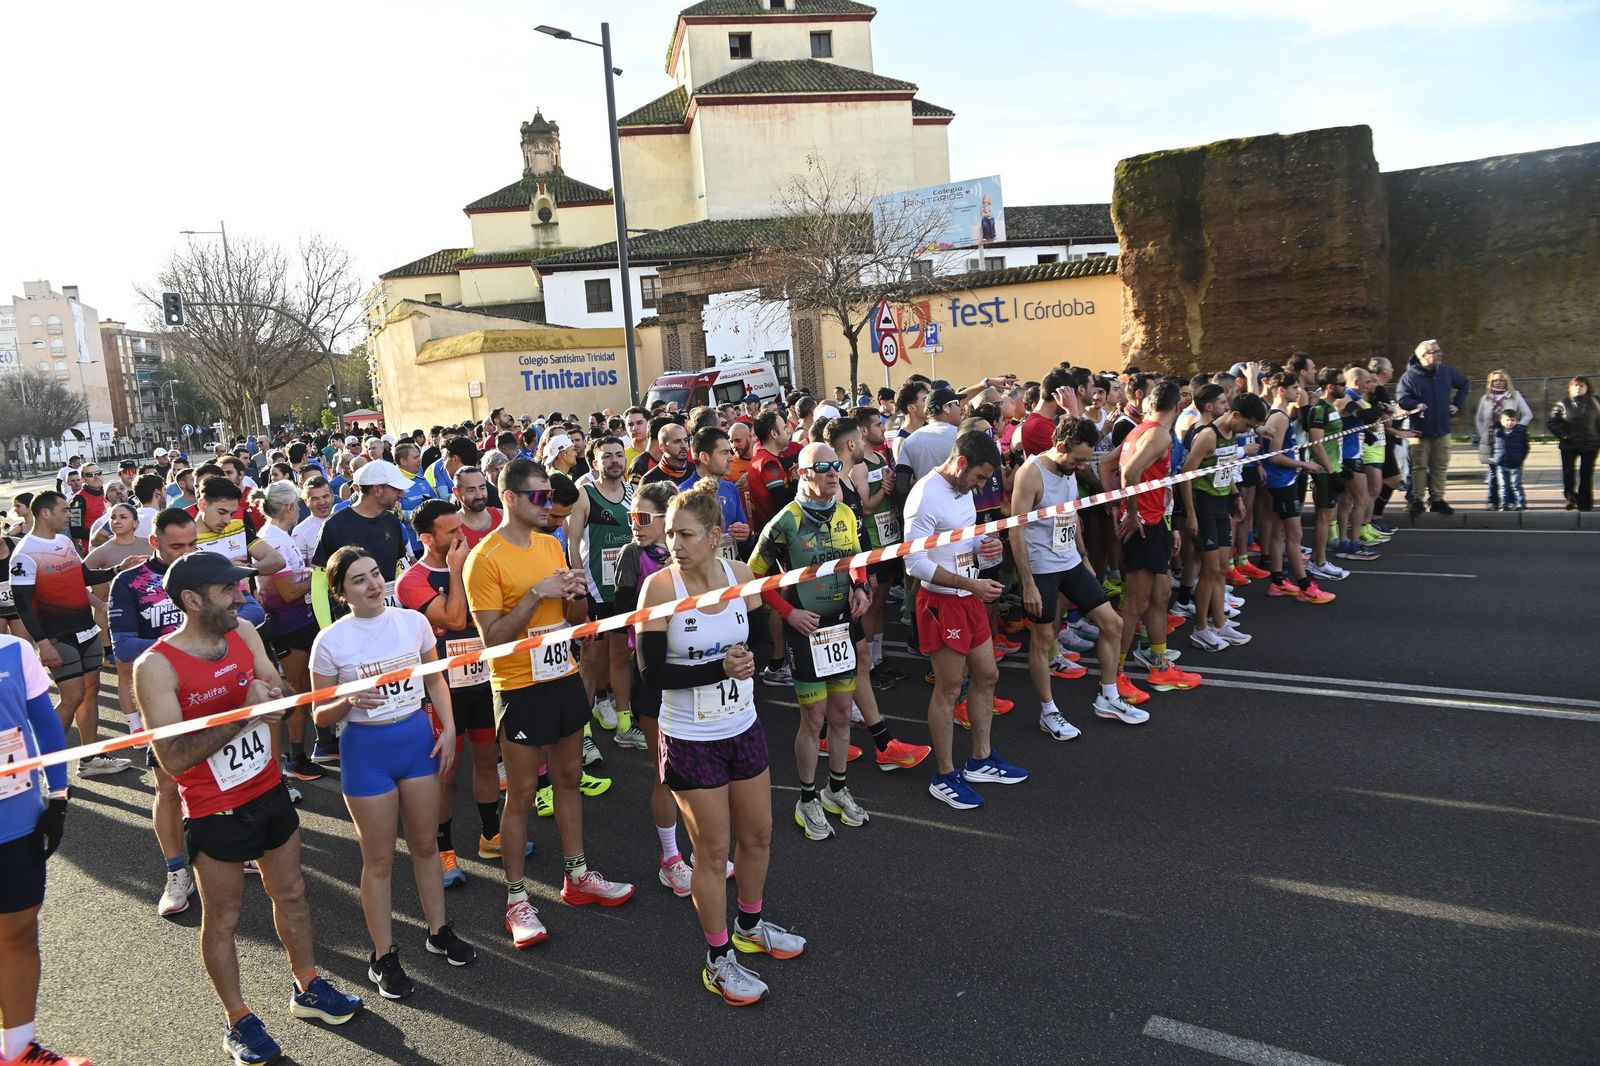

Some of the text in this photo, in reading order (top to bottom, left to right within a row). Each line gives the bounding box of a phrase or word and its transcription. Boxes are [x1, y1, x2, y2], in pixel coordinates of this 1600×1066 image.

[932, 186, 963, 196] Colegio
[947, 297, 1096, 327] fest Córdoba
[926, 325, 936, 338] P
[884, 344, 895, 357] 20
[518, 352, 615, 367] Colegio Santísima Trinidad
[520, 367, 618, 391] Trinitarios
[883, 520, 898, 538] 290
[160, 603, 181, 614] MED
[735, 611, 745, 625] in
[543, 640, 568, 667] 483
[824, 640, 849, 664] 182
[197, 685, 227, 702] califas
[716, 679, 739, 706] 14
[222, 730, 265, 771] 244
